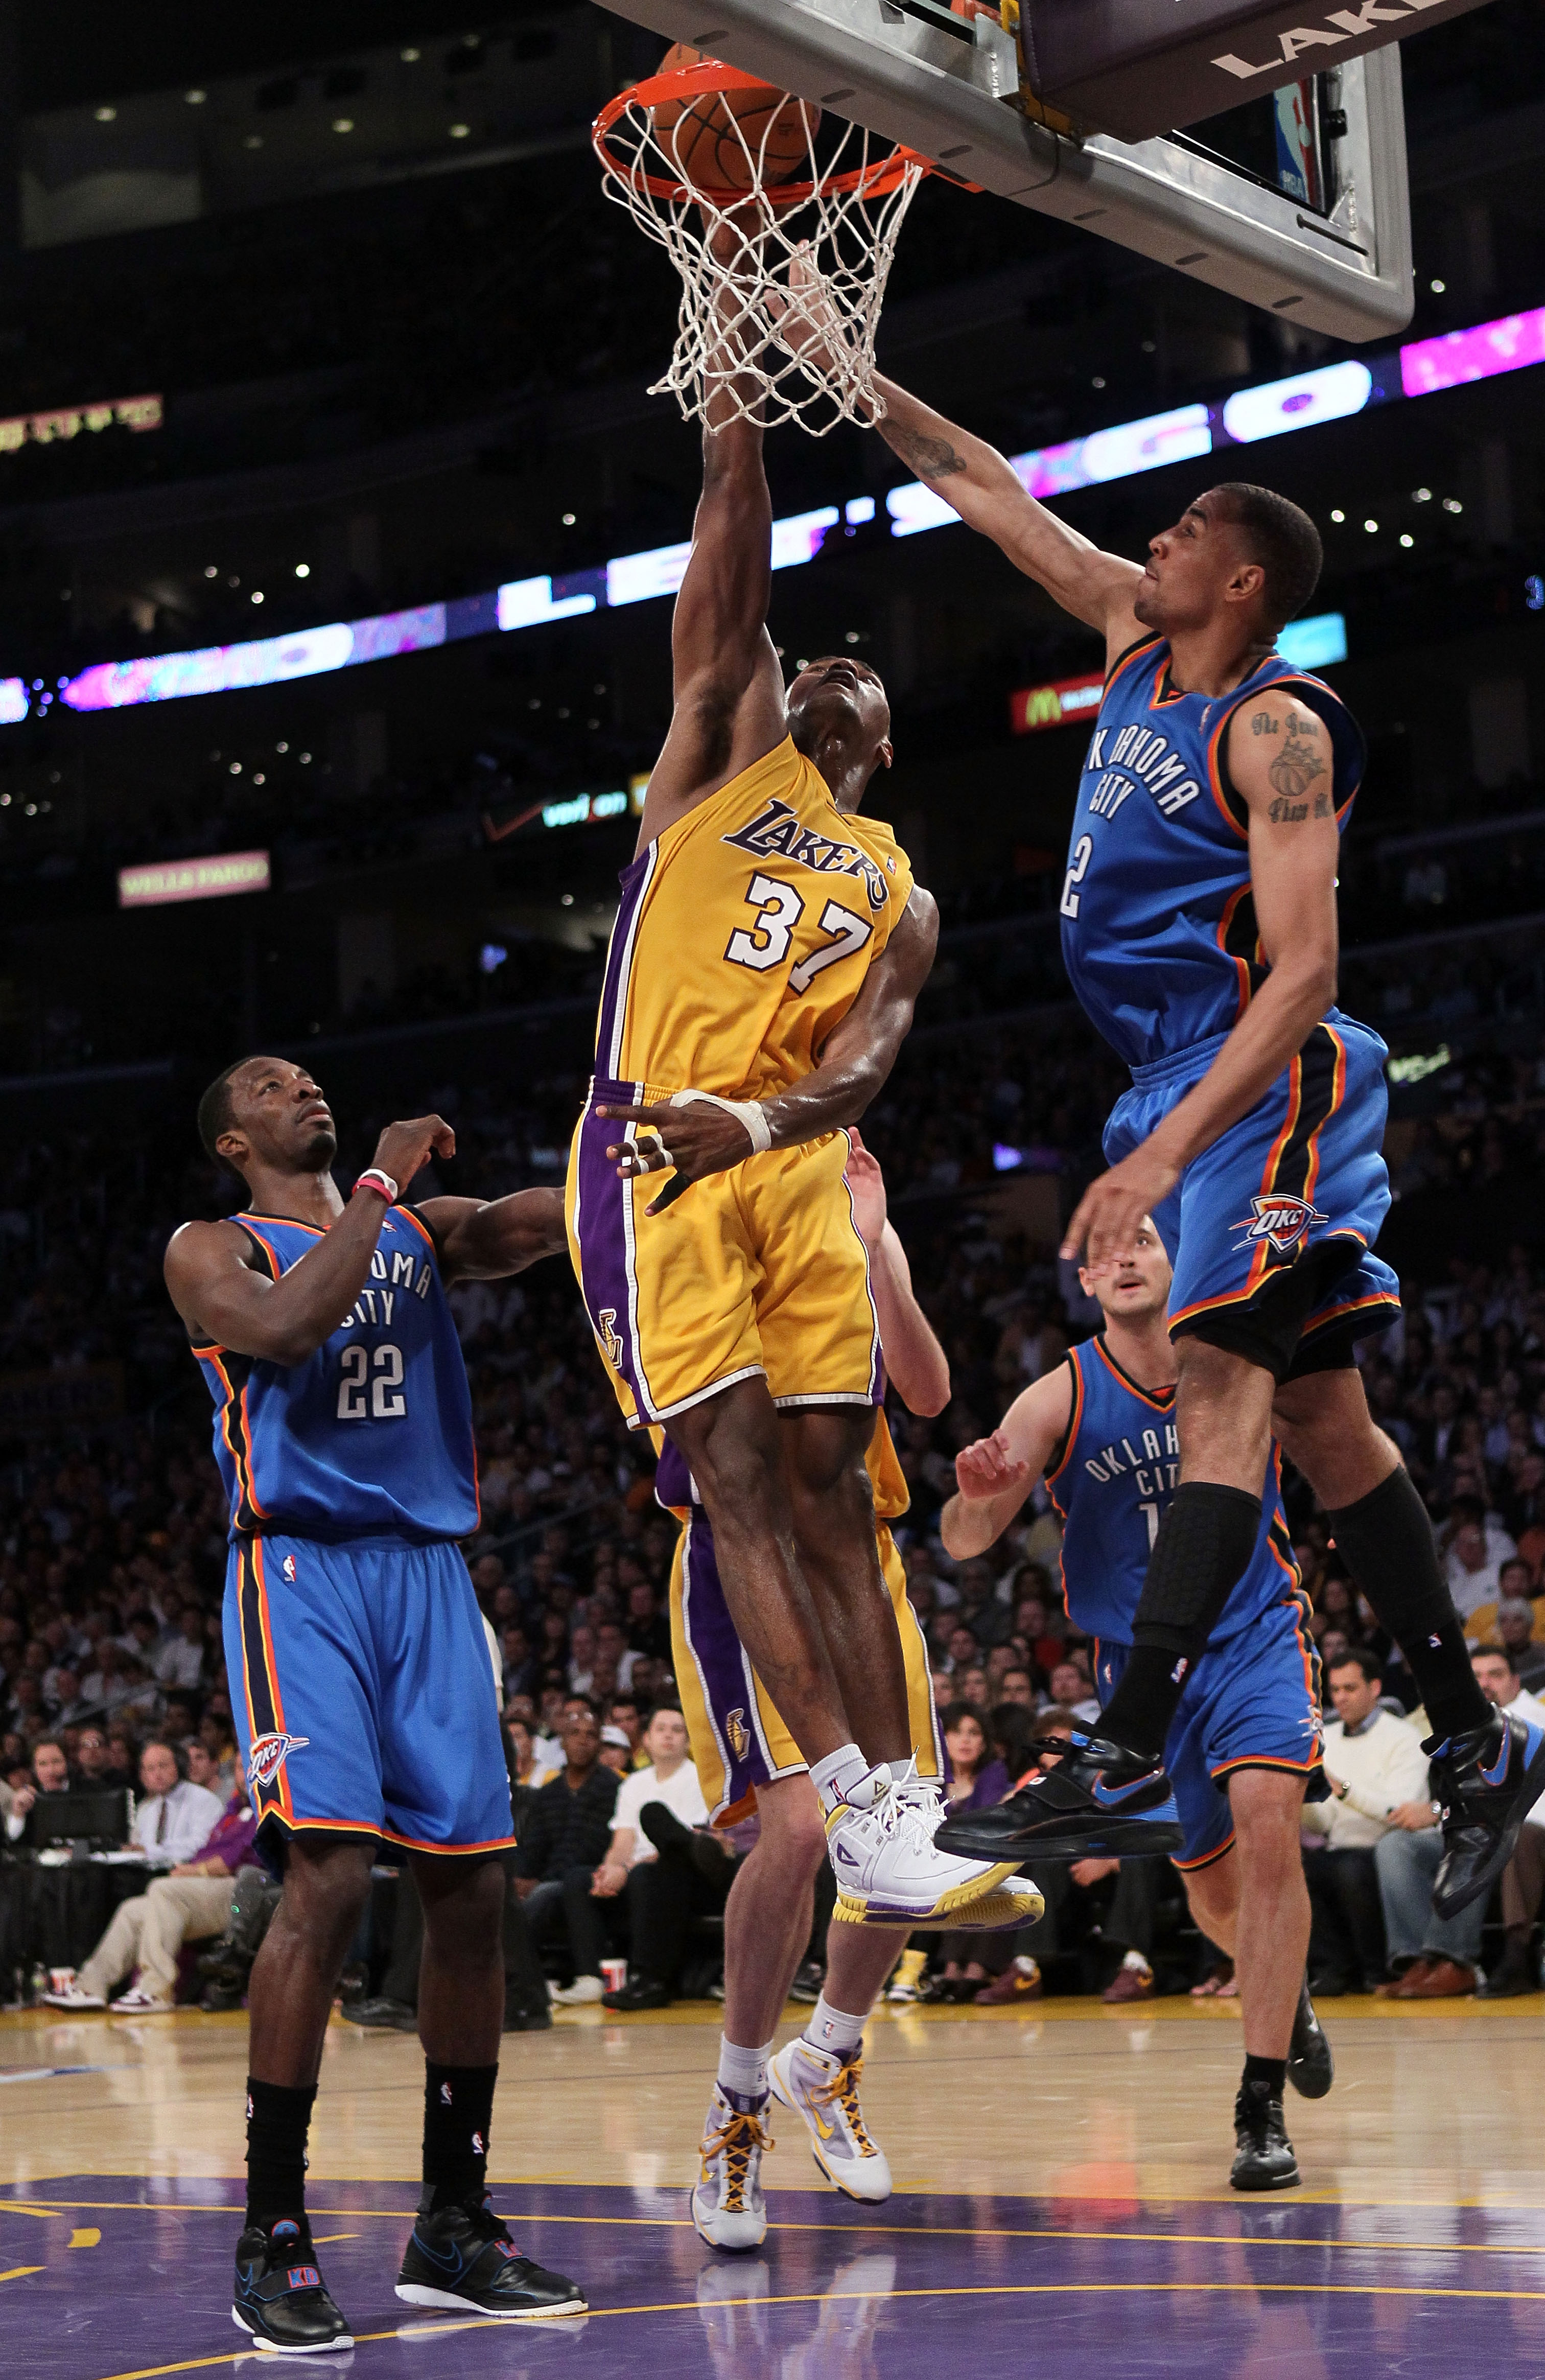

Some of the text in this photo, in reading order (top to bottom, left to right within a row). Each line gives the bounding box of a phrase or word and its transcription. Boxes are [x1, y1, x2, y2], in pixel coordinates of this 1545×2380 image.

[1082, 360, 1372, 482] GO
[1088, 724, 1200, 816] KLAHOMA
[1088, 773, 1135, 820] CITY
[719, 799, 890, 913] LAKERS
[1060, 834, 1092, 918] 2
[722, 870, 875, 997] 37
[1251, 1209, 1303, 1235] OKC
[337, 1345, 406, 1418] 22
[1085, 1424, 1179, 1482] OKLAH
[1135, 1462, 1178, 1496] CIT
[287, 2267, 321, 2289] KD
